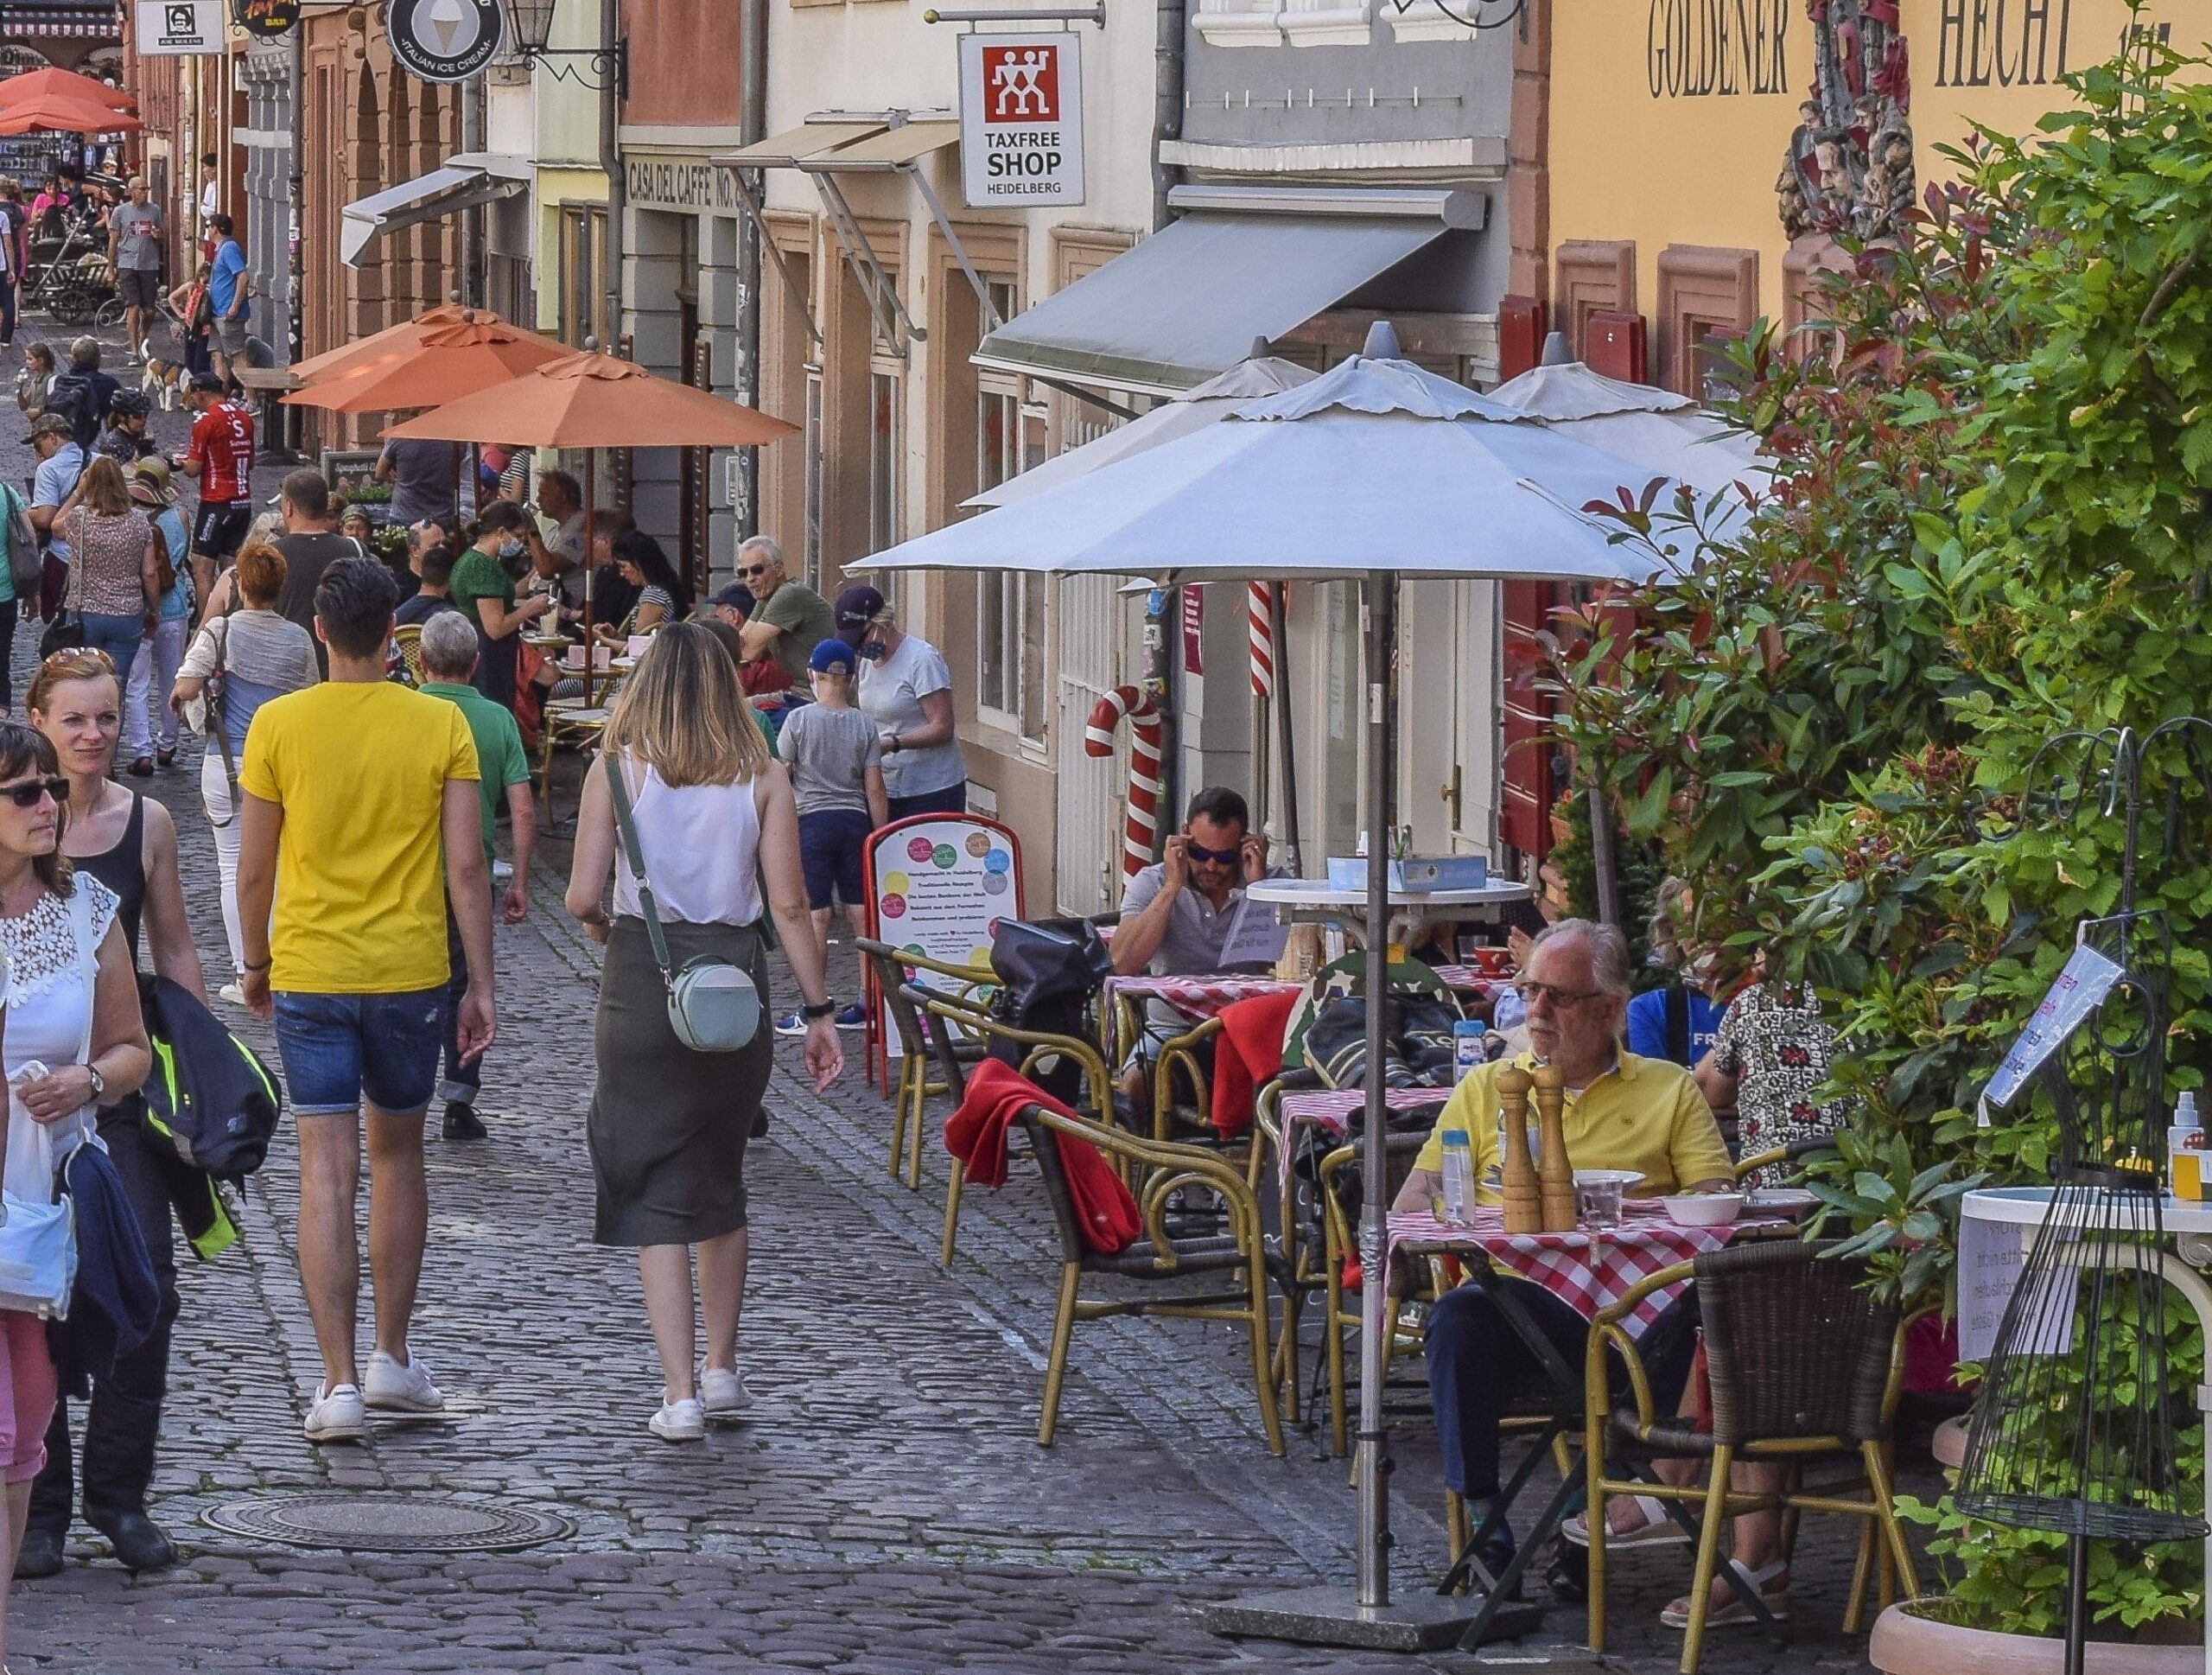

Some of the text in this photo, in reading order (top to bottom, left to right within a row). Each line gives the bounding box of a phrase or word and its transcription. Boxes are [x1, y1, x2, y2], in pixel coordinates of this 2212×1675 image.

[1648, 0, 1788, 99] GOLDENER
[984, 131, 1060, 148] TAXFREE
[988, 151, 1062, 177] SHOP
[630, 162, 654, 202] CASA
[657, 163, 676, 203] DEL
[988, 182, 1061, 194] HEIDELBERG
